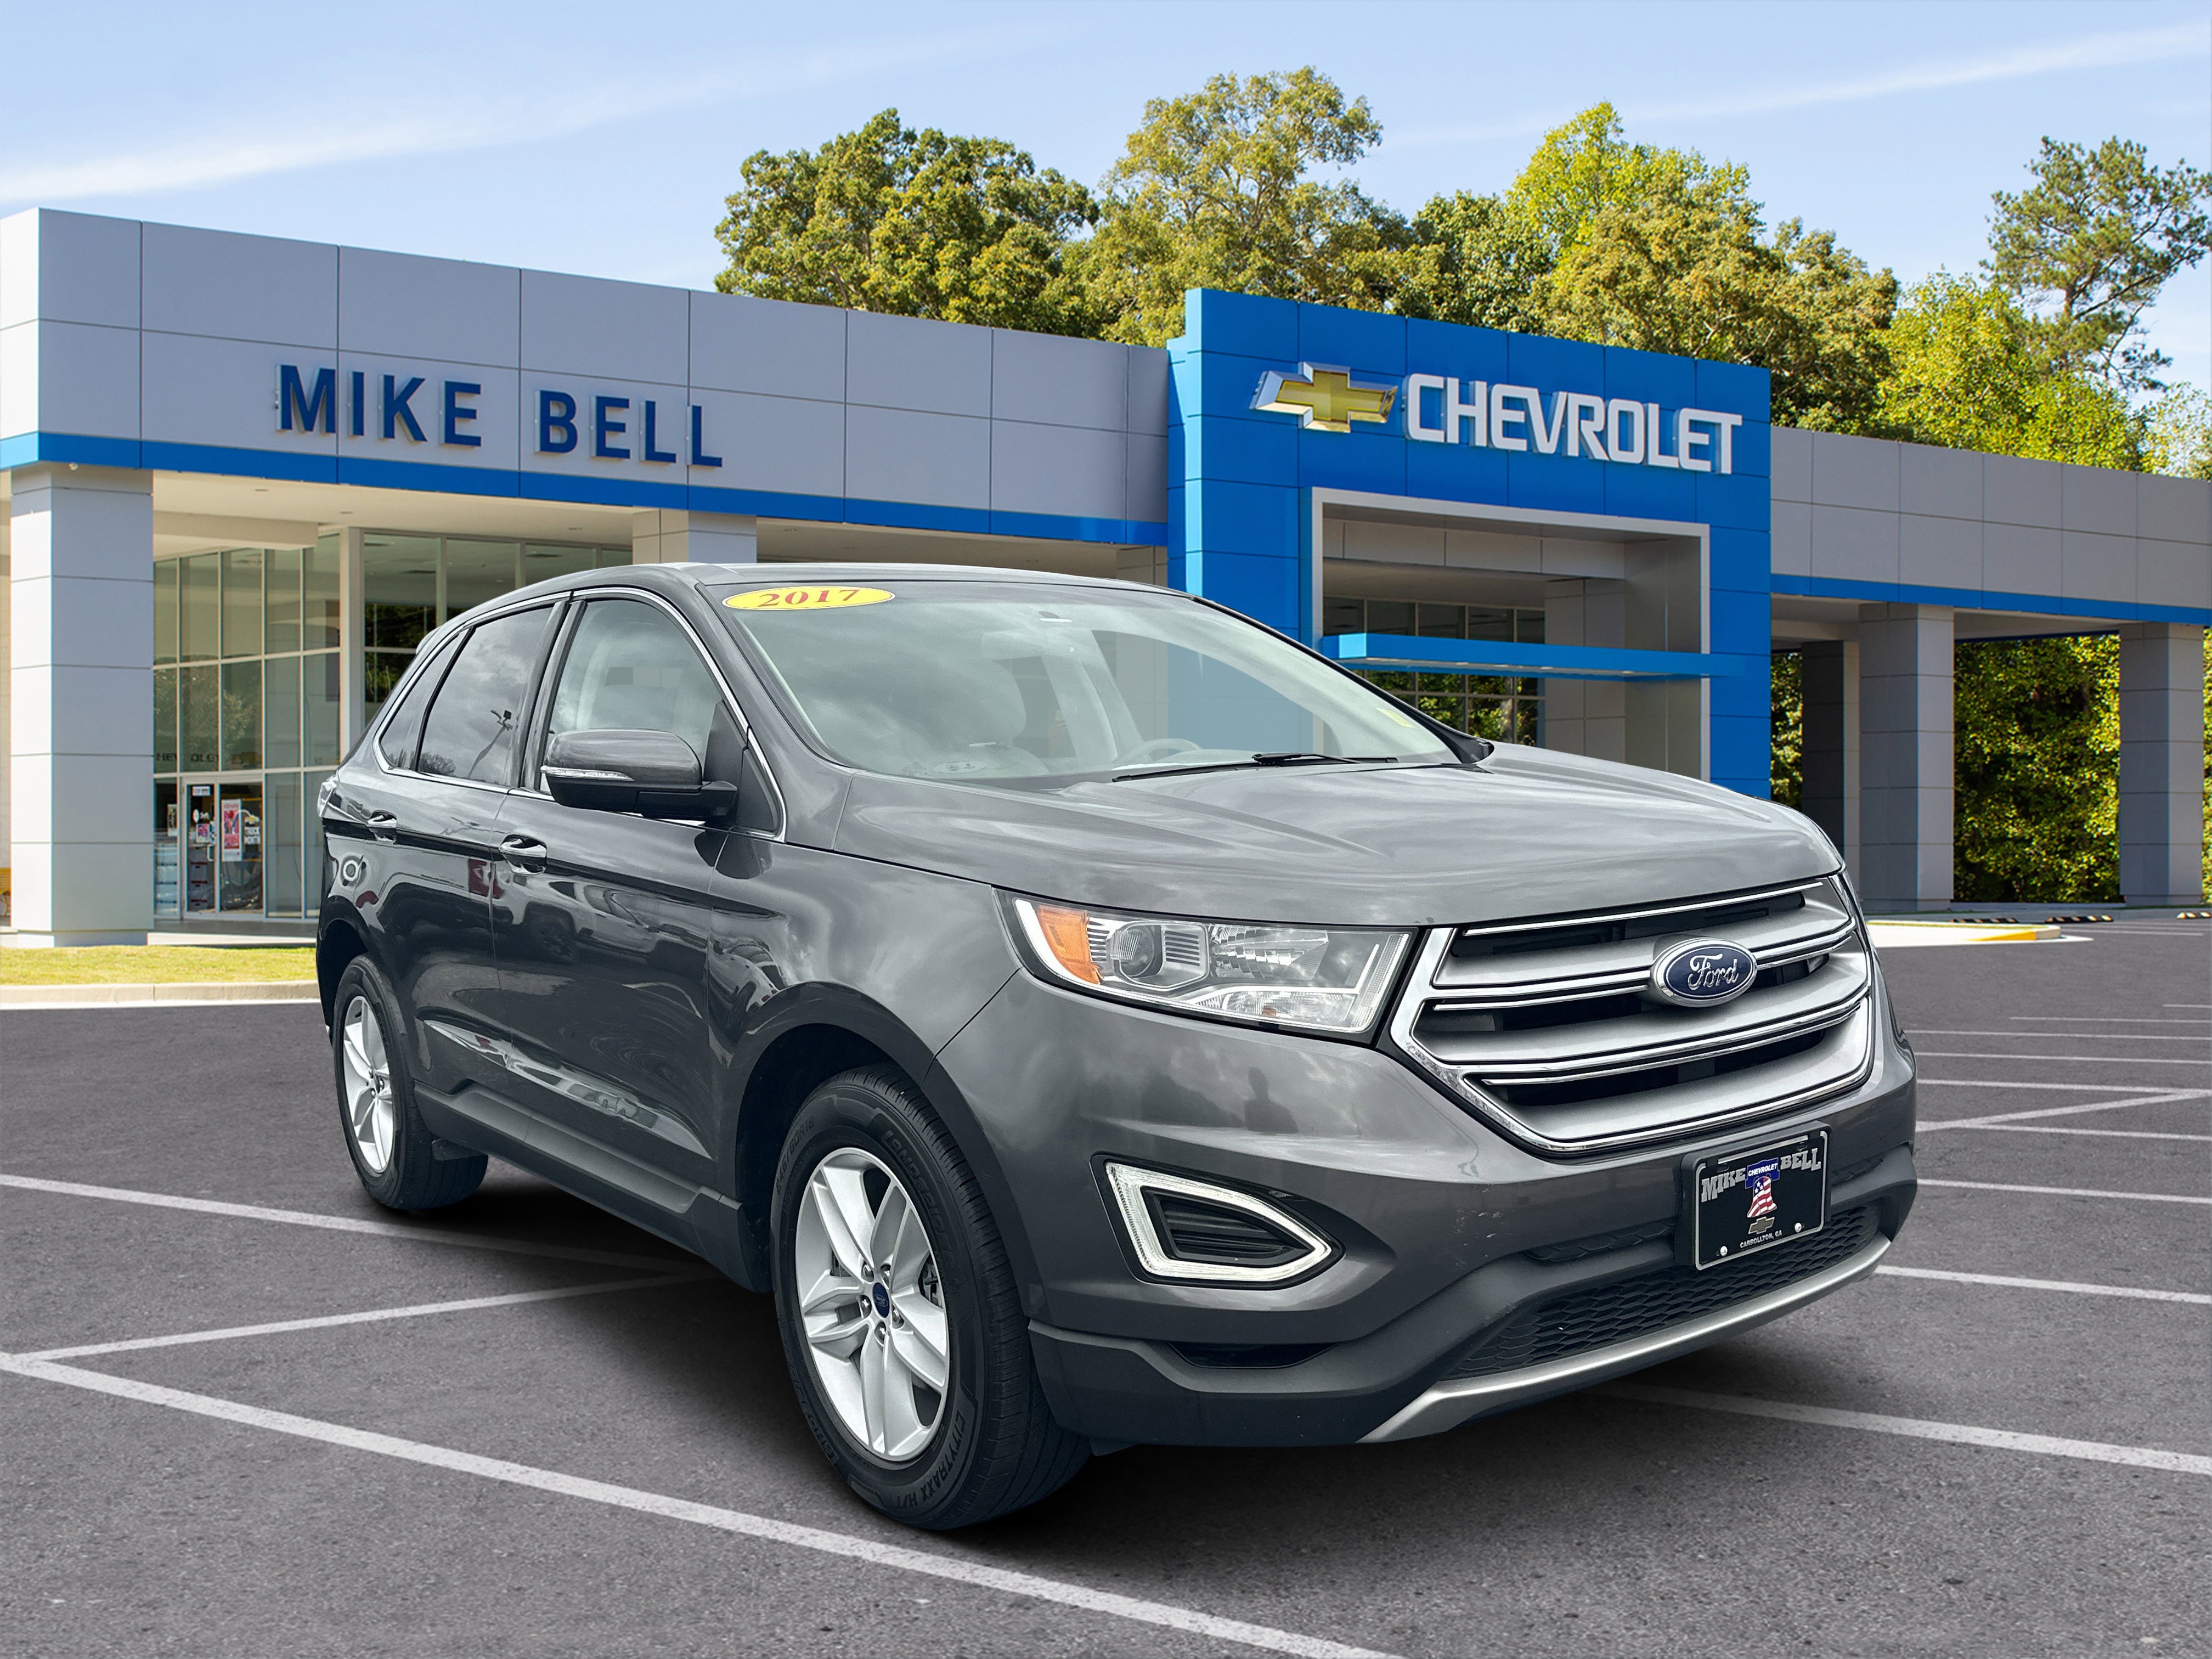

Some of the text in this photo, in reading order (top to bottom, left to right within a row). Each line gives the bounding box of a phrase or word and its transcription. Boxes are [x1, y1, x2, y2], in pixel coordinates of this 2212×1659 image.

[276, 364, 723, 467] MIKE BELL
[1402, 373, 1742, 475] CHEVROLET
[758, 589, 860, 607] 2017
[1688, 953, 1739, 991] Ford
[1701, 1148, 1821, 1203] MIKE BELL
[1748, 1163, 1779, 1177] CHEVROLET
[1740, 1233, 1774, 1249] CARROLLTON,
[895, 1409, 966, 1508] CITYTRAXX H/T
